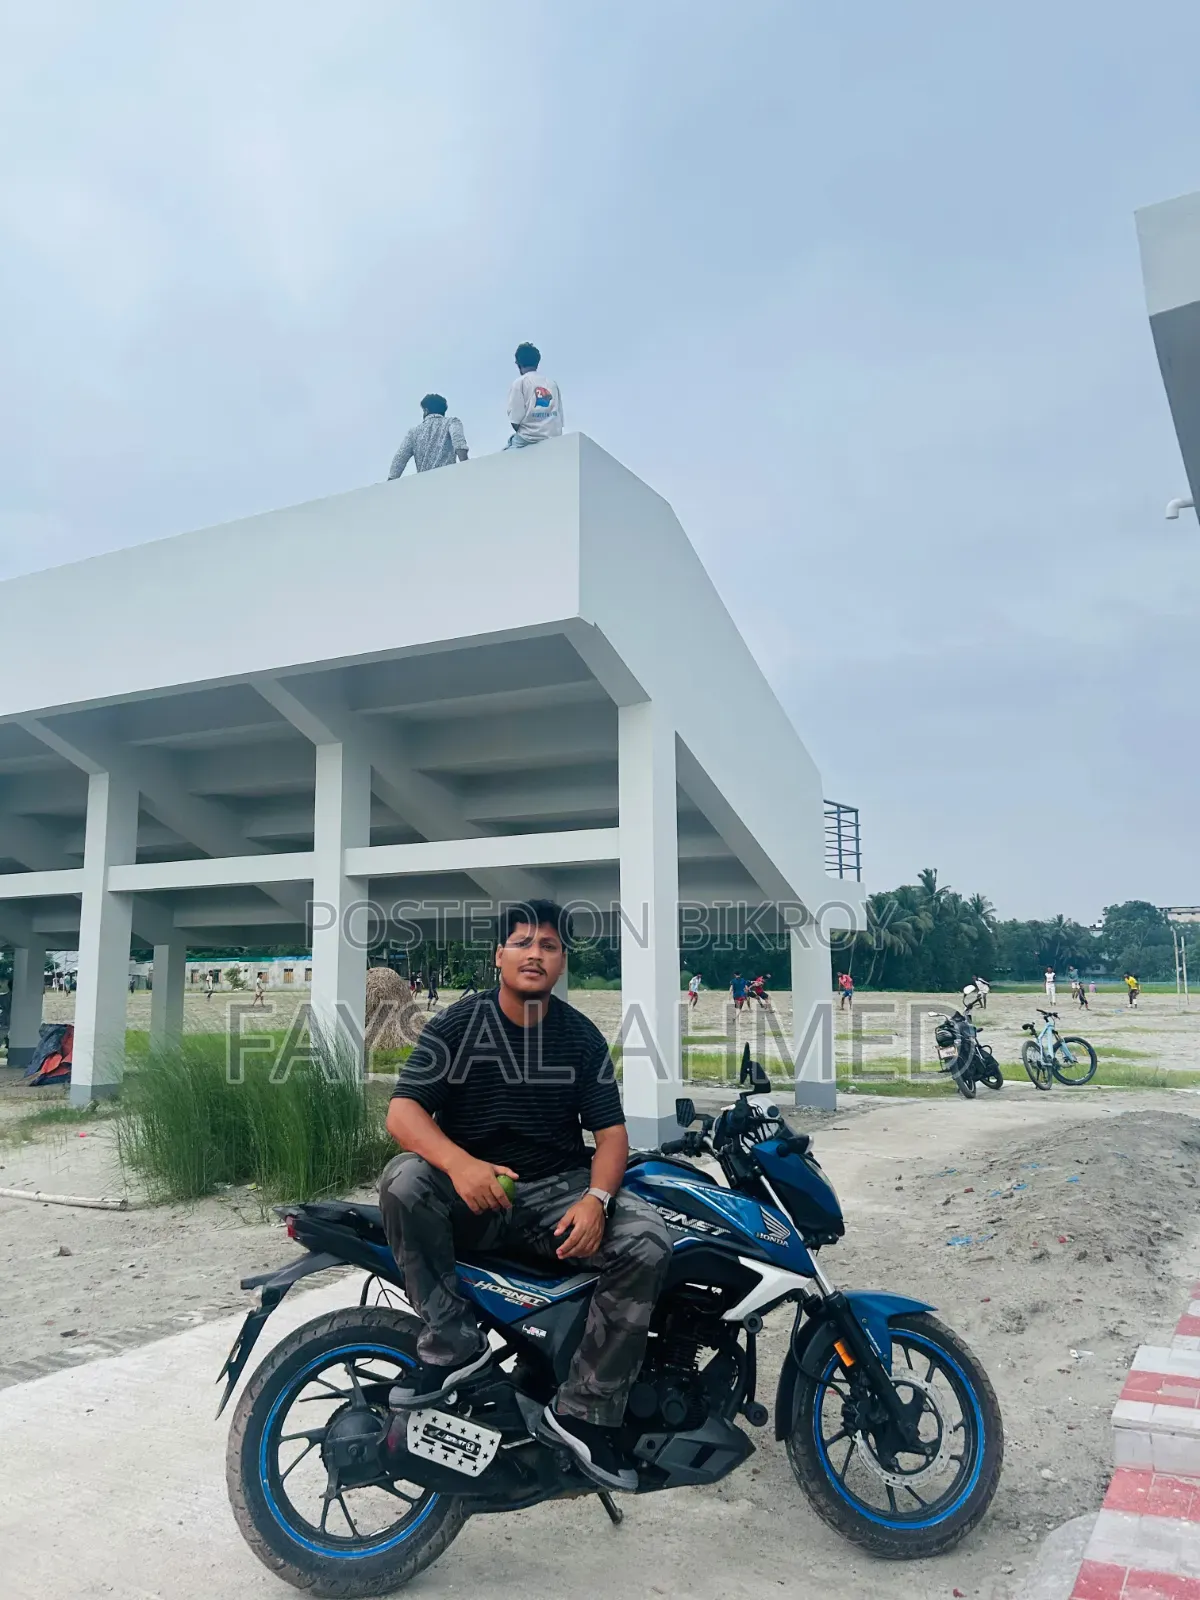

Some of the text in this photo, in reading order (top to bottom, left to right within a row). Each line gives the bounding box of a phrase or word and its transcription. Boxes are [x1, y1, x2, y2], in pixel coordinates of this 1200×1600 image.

[649, 1203, 732, 1236] RNET
[756, 1232, 790, 1248] HONDA
[474, 1280, 544, 1304] HORNET
